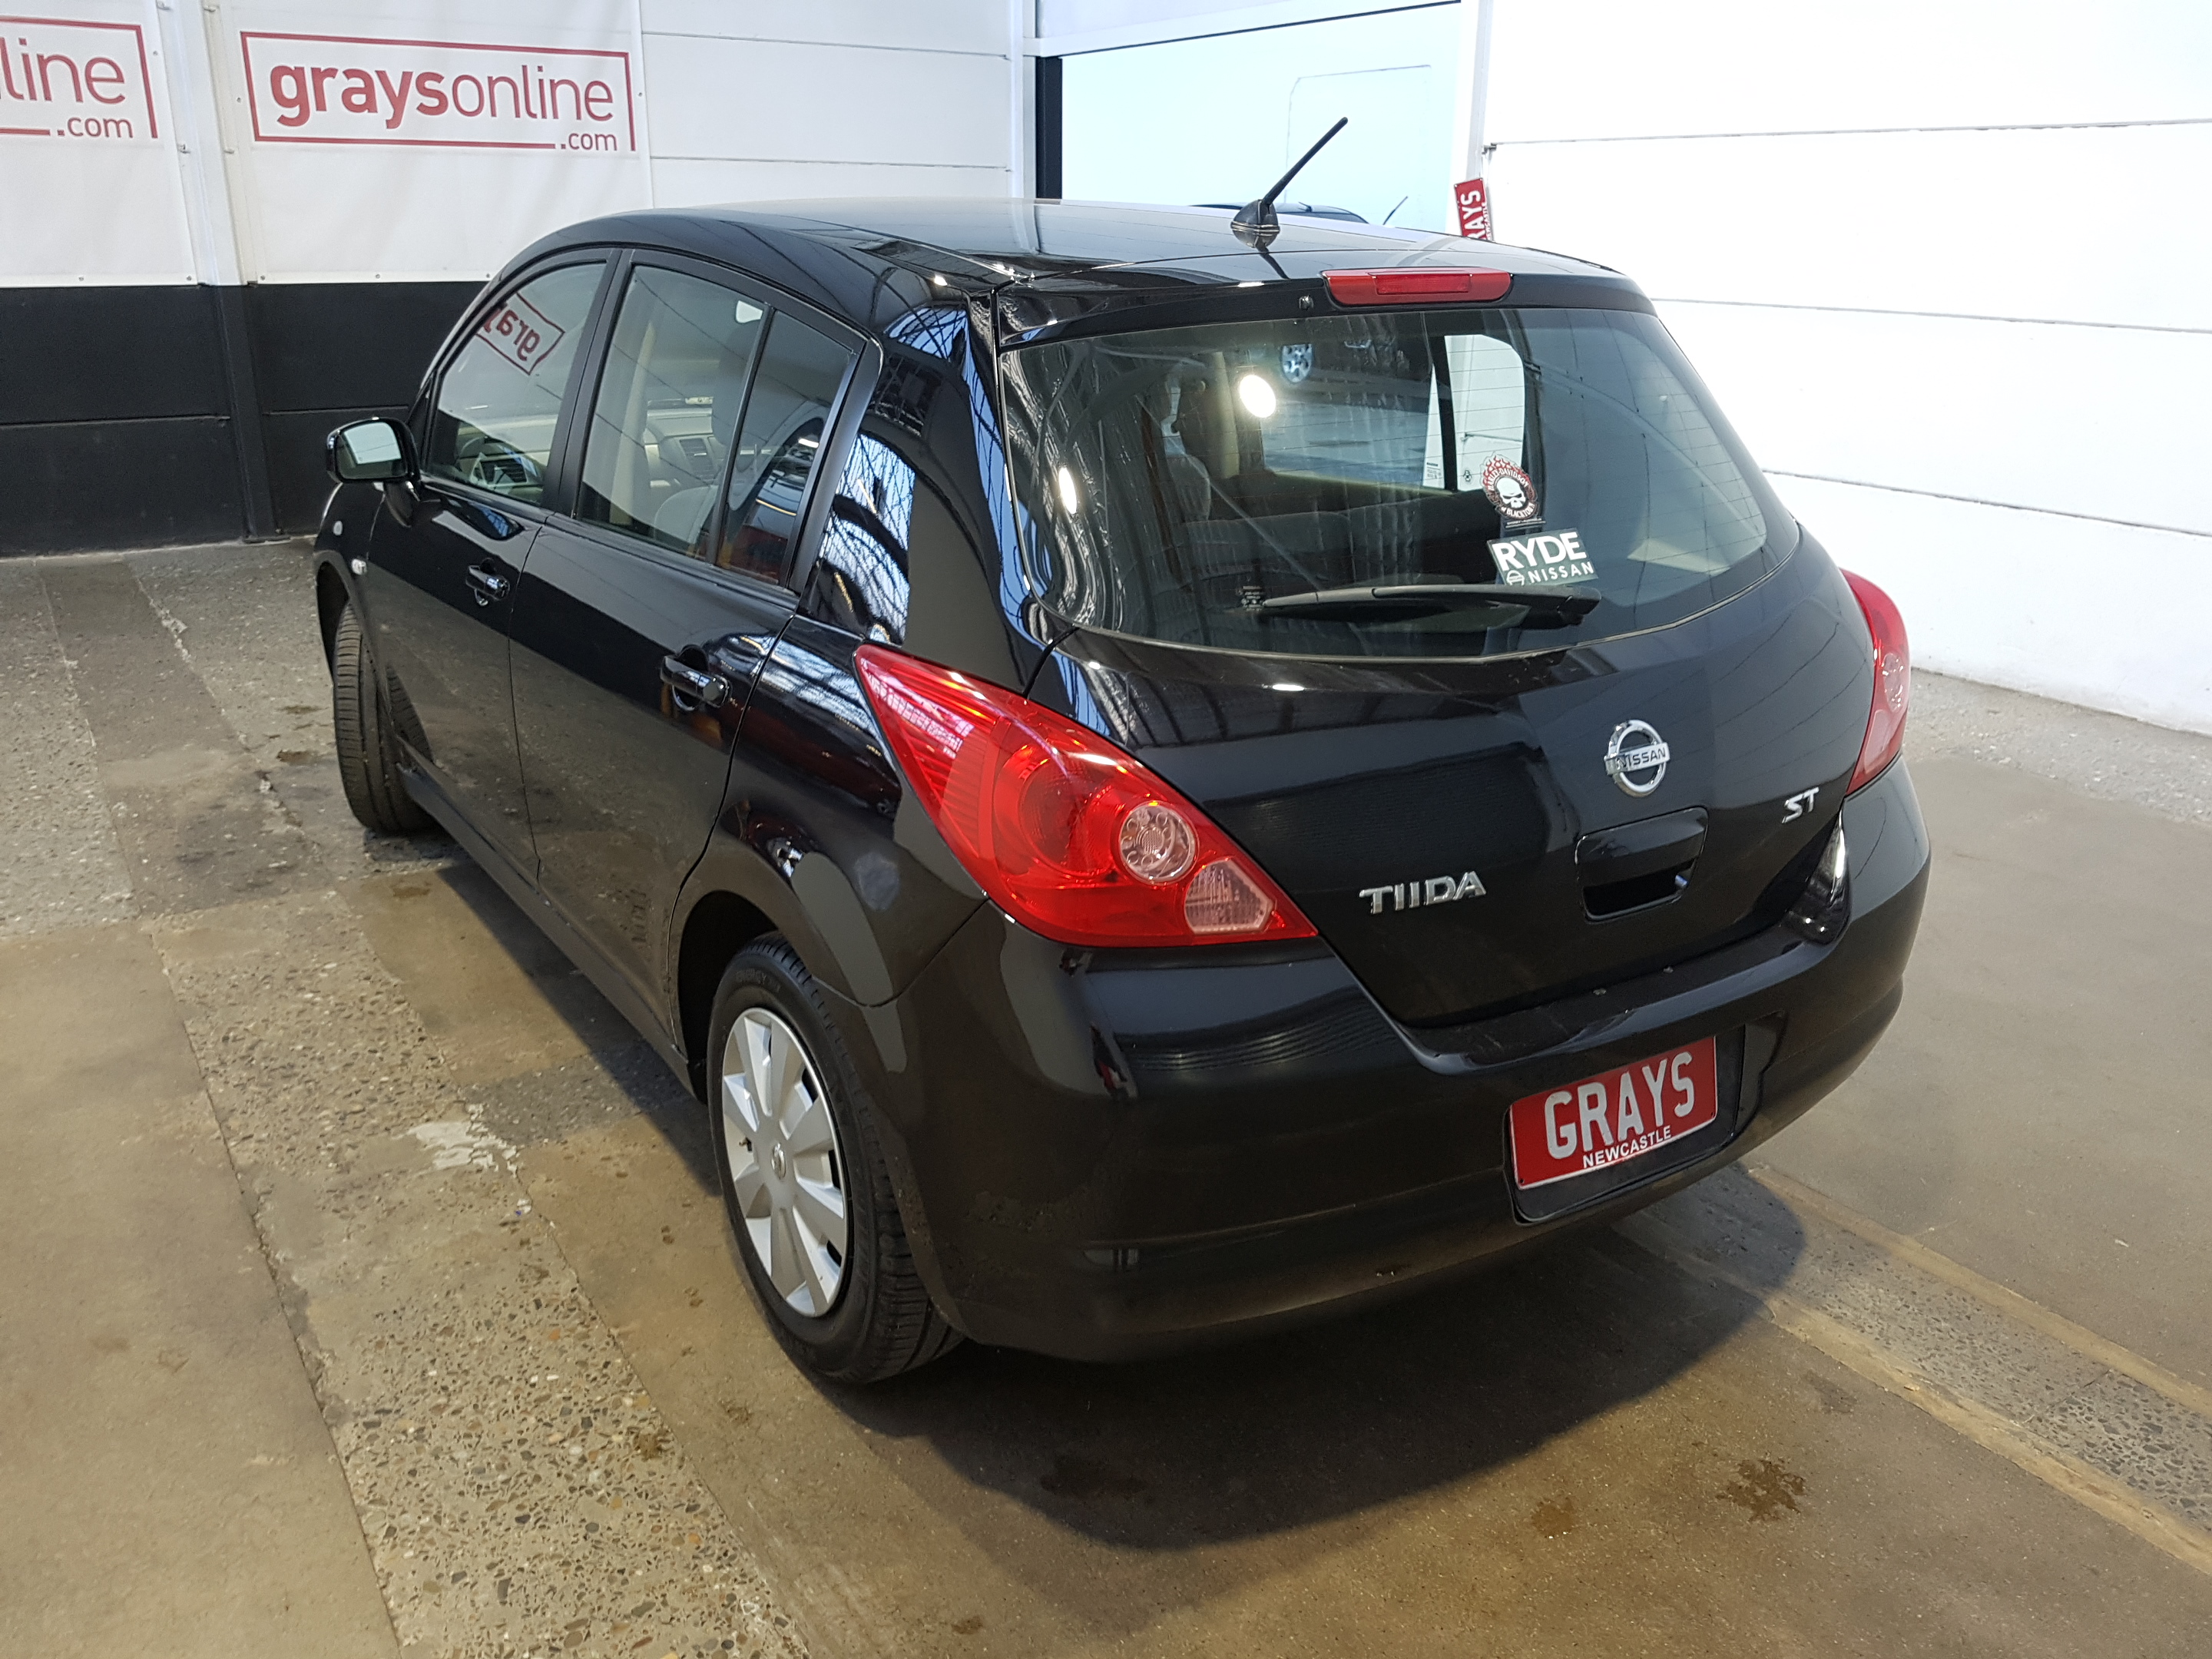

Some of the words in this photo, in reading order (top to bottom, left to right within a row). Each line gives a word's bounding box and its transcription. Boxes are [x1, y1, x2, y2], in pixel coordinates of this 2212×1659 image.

[0, 37, 126, 104] line
[270, 65, 614, 129] graysonline
[57, 117, 134, 138] .com
[561, 132, 618, 151] .com
[1492, 531, 1588, 571] RYDE
[1527, 561, 1594, 584] NISSAN
[1615, 747, 1667, 769] NISSAN
[1781, 786, 1820, 824] ST
[1359, 870, 1487, 915] TIIDA
[1544, 1051, 1695, 1160] GRAYS
[1582, 1125, 1672, 1169] NEWCASTLE
